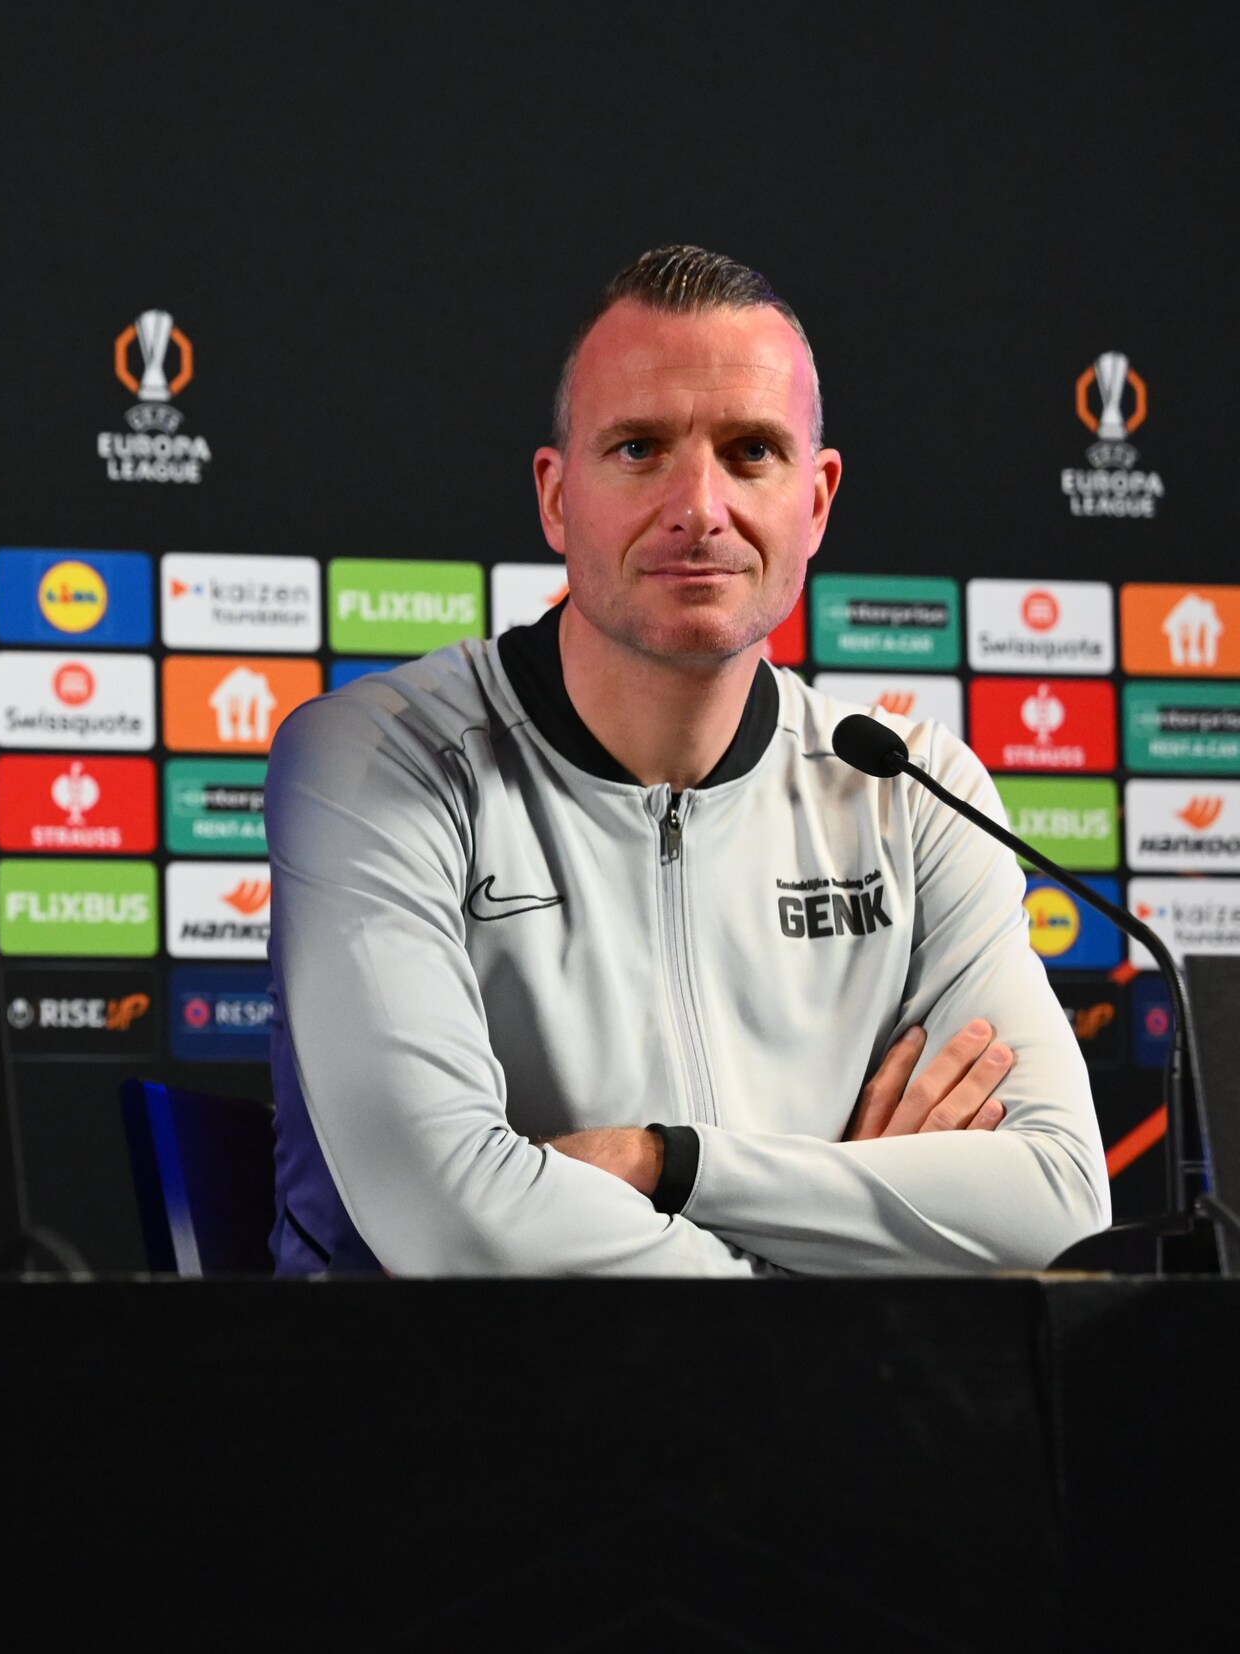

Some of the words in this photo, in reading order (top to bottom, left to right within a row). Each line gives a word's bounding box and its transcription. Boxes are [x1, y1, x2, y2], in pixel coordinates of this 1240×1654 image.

[97, 431, 212, 462] EUROPA
[107, 458, 202, 484] LEAGUE
[1061, 468, 1164, 498] EUROPA
[1070, 493, 1156, 519] LEAGUE
[210, 577, 310, 603] kaizen
[978, 630, 1103, 663] Swissquote
[6, 707, 143, 737] Swissquote
[31, 825, 122, 848] STRAUSS
[778, 885, 893, 939] GENK
[215, 1000, 274, 1027] RESP
